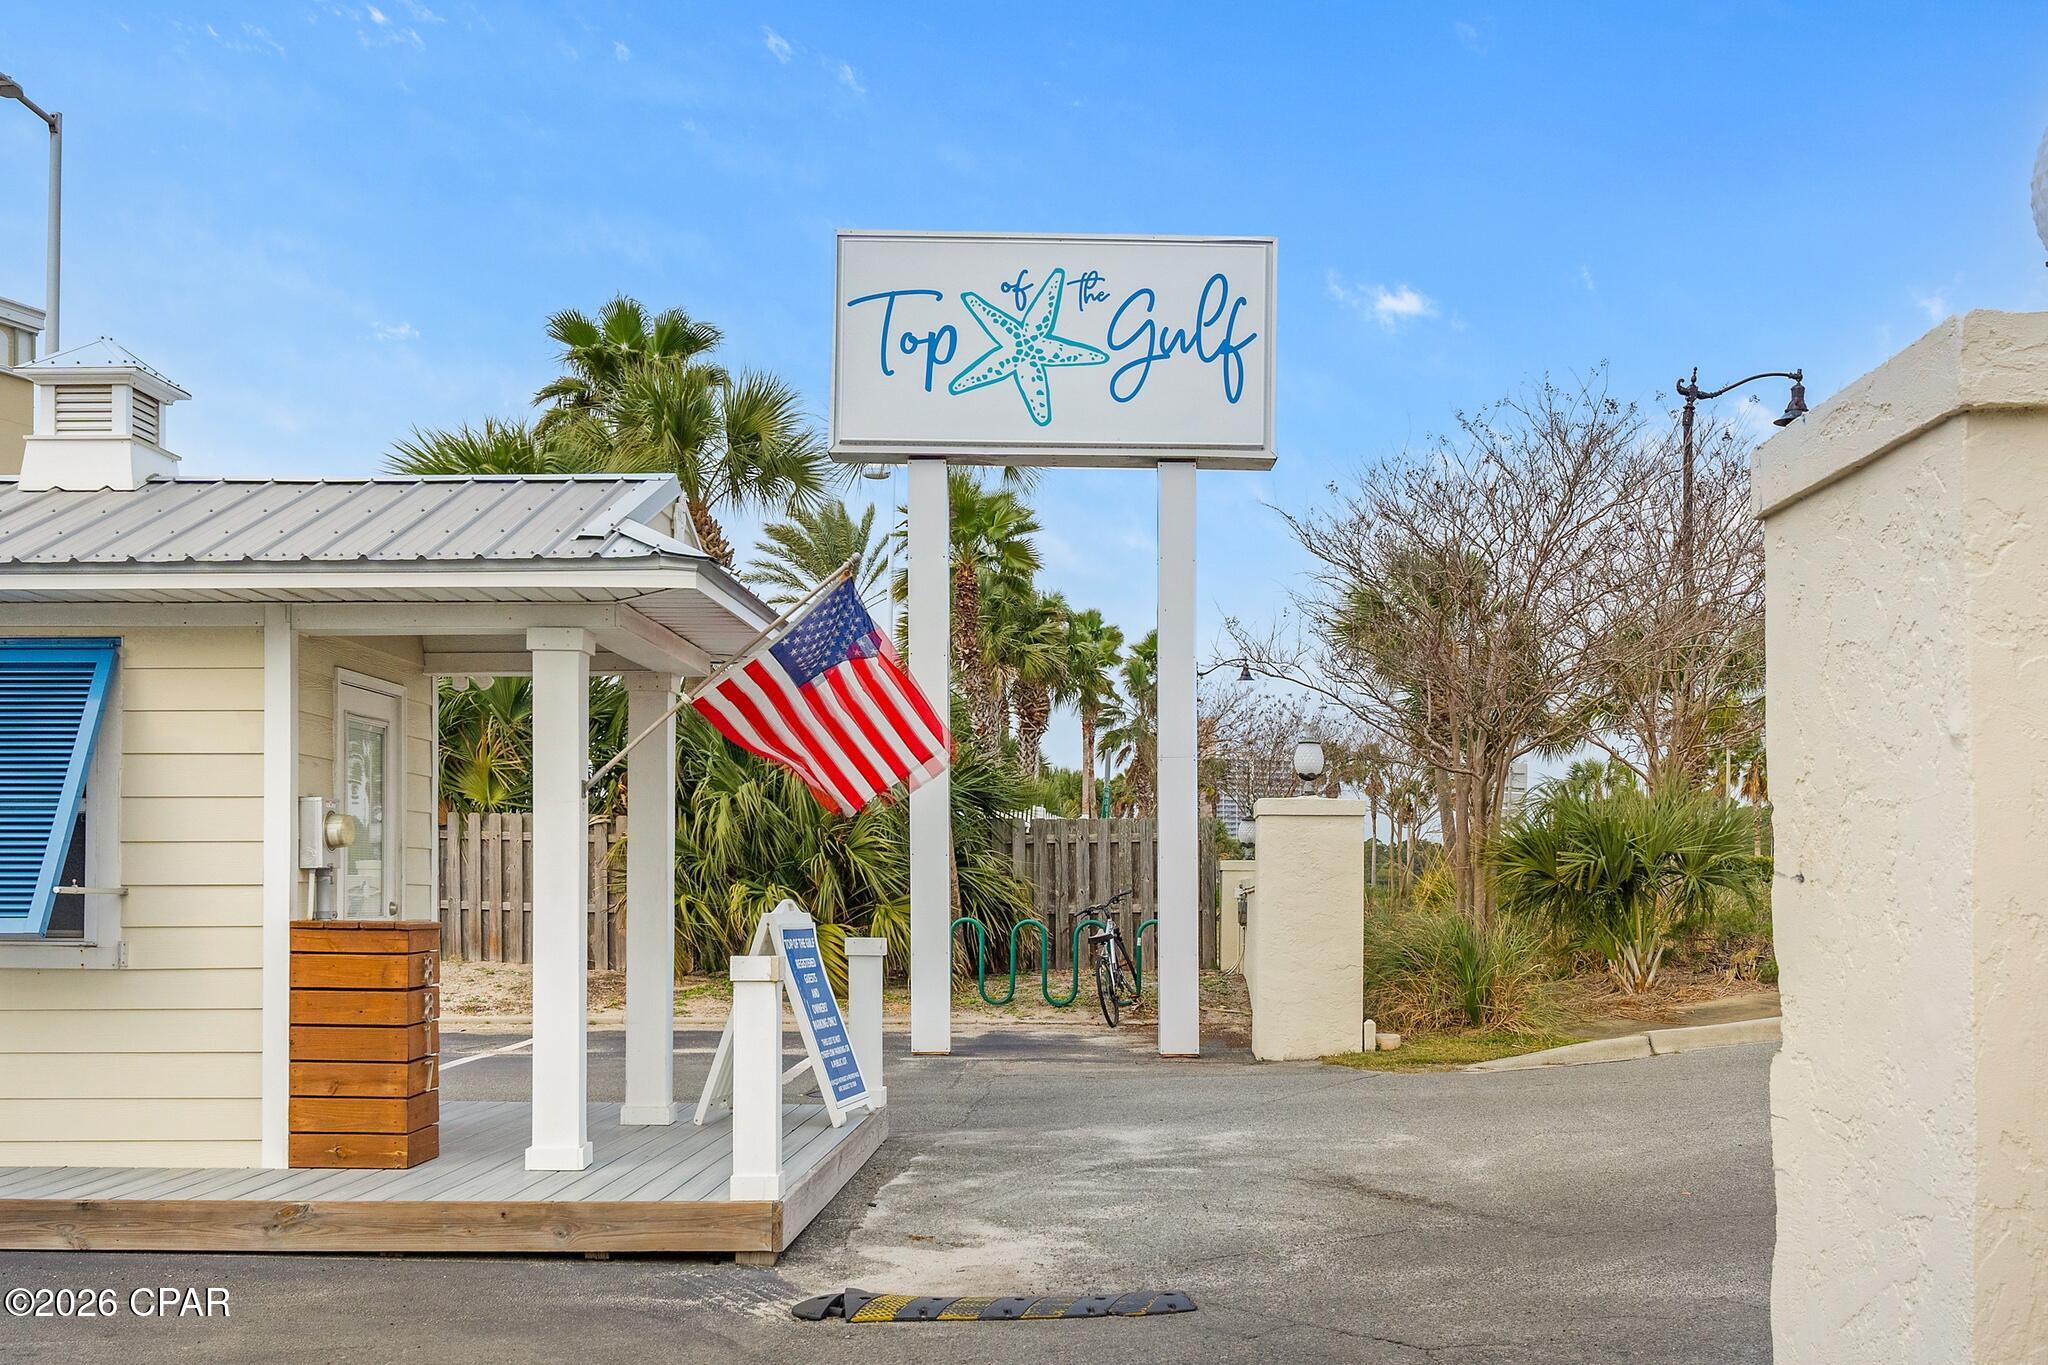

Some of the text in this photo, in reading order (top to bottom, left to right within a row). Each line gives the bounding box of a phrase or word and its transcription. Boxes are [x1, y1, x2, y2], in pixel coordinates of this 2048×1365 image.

[847, 269, 1257, 404] Top of the Gulf
